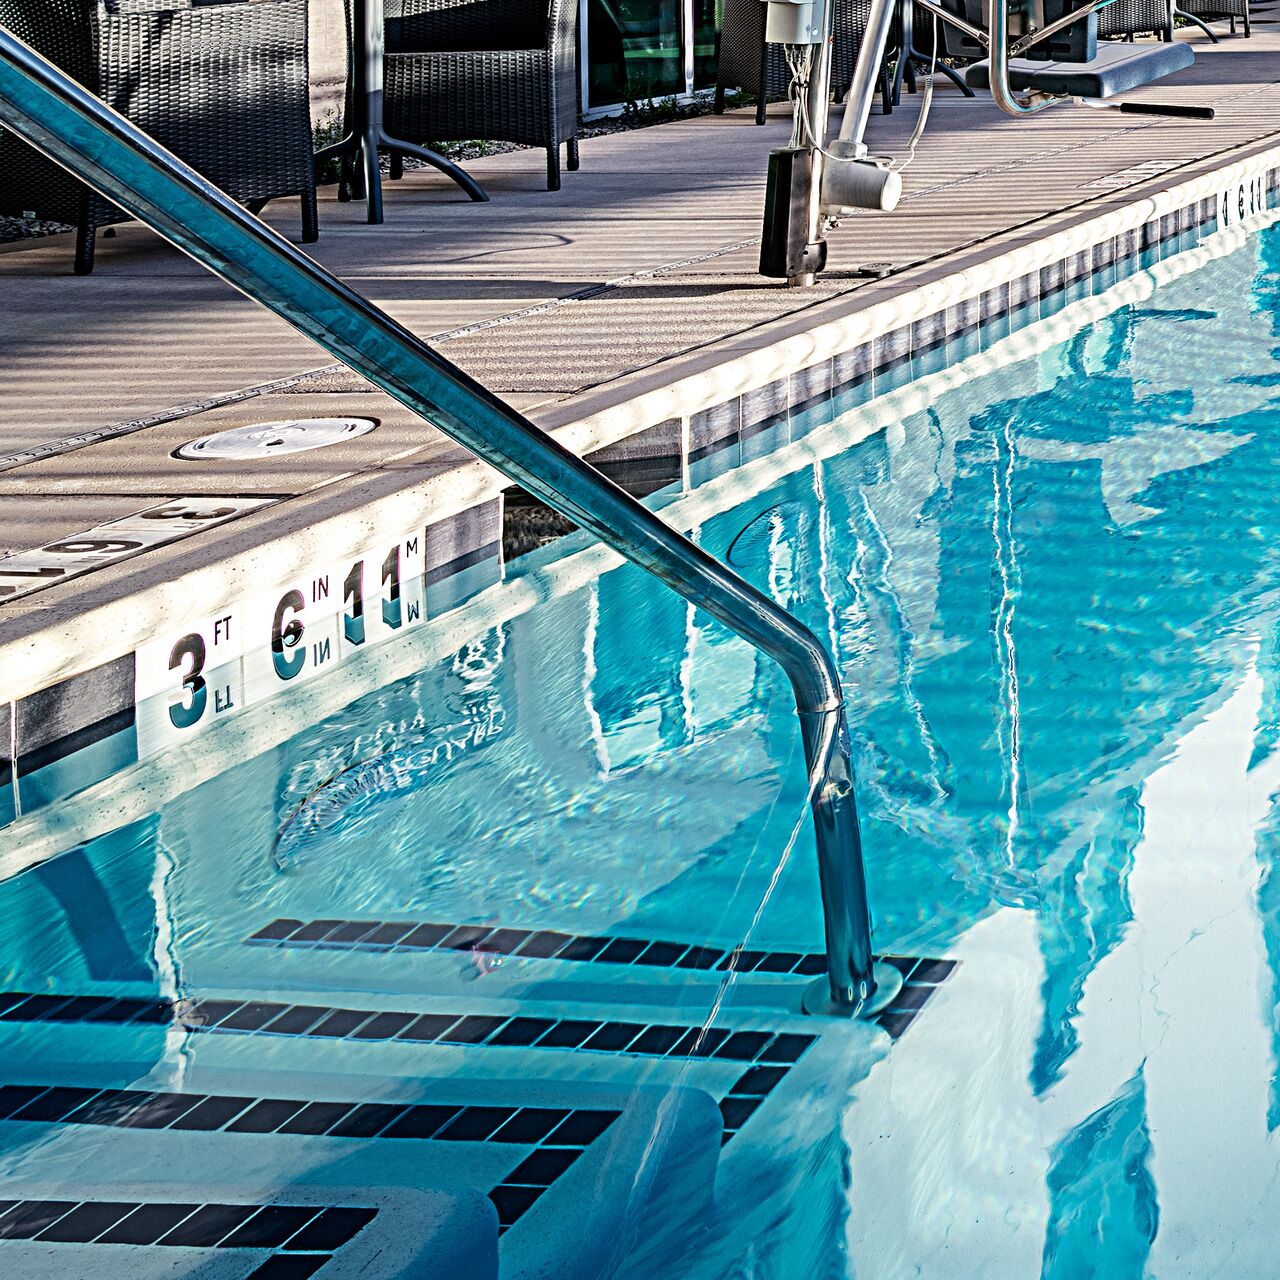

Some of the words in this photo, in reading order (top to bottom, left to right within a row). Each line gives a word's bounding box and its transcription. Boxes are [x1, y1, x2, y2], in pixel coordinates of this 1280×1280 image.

[168, 632, 206, 707] 3
[214, 615, 232, 646] FT
[272, 589, 306, 665] 6
[312, 575, 329, 603] IN
[406, 537, 418, 558] M
